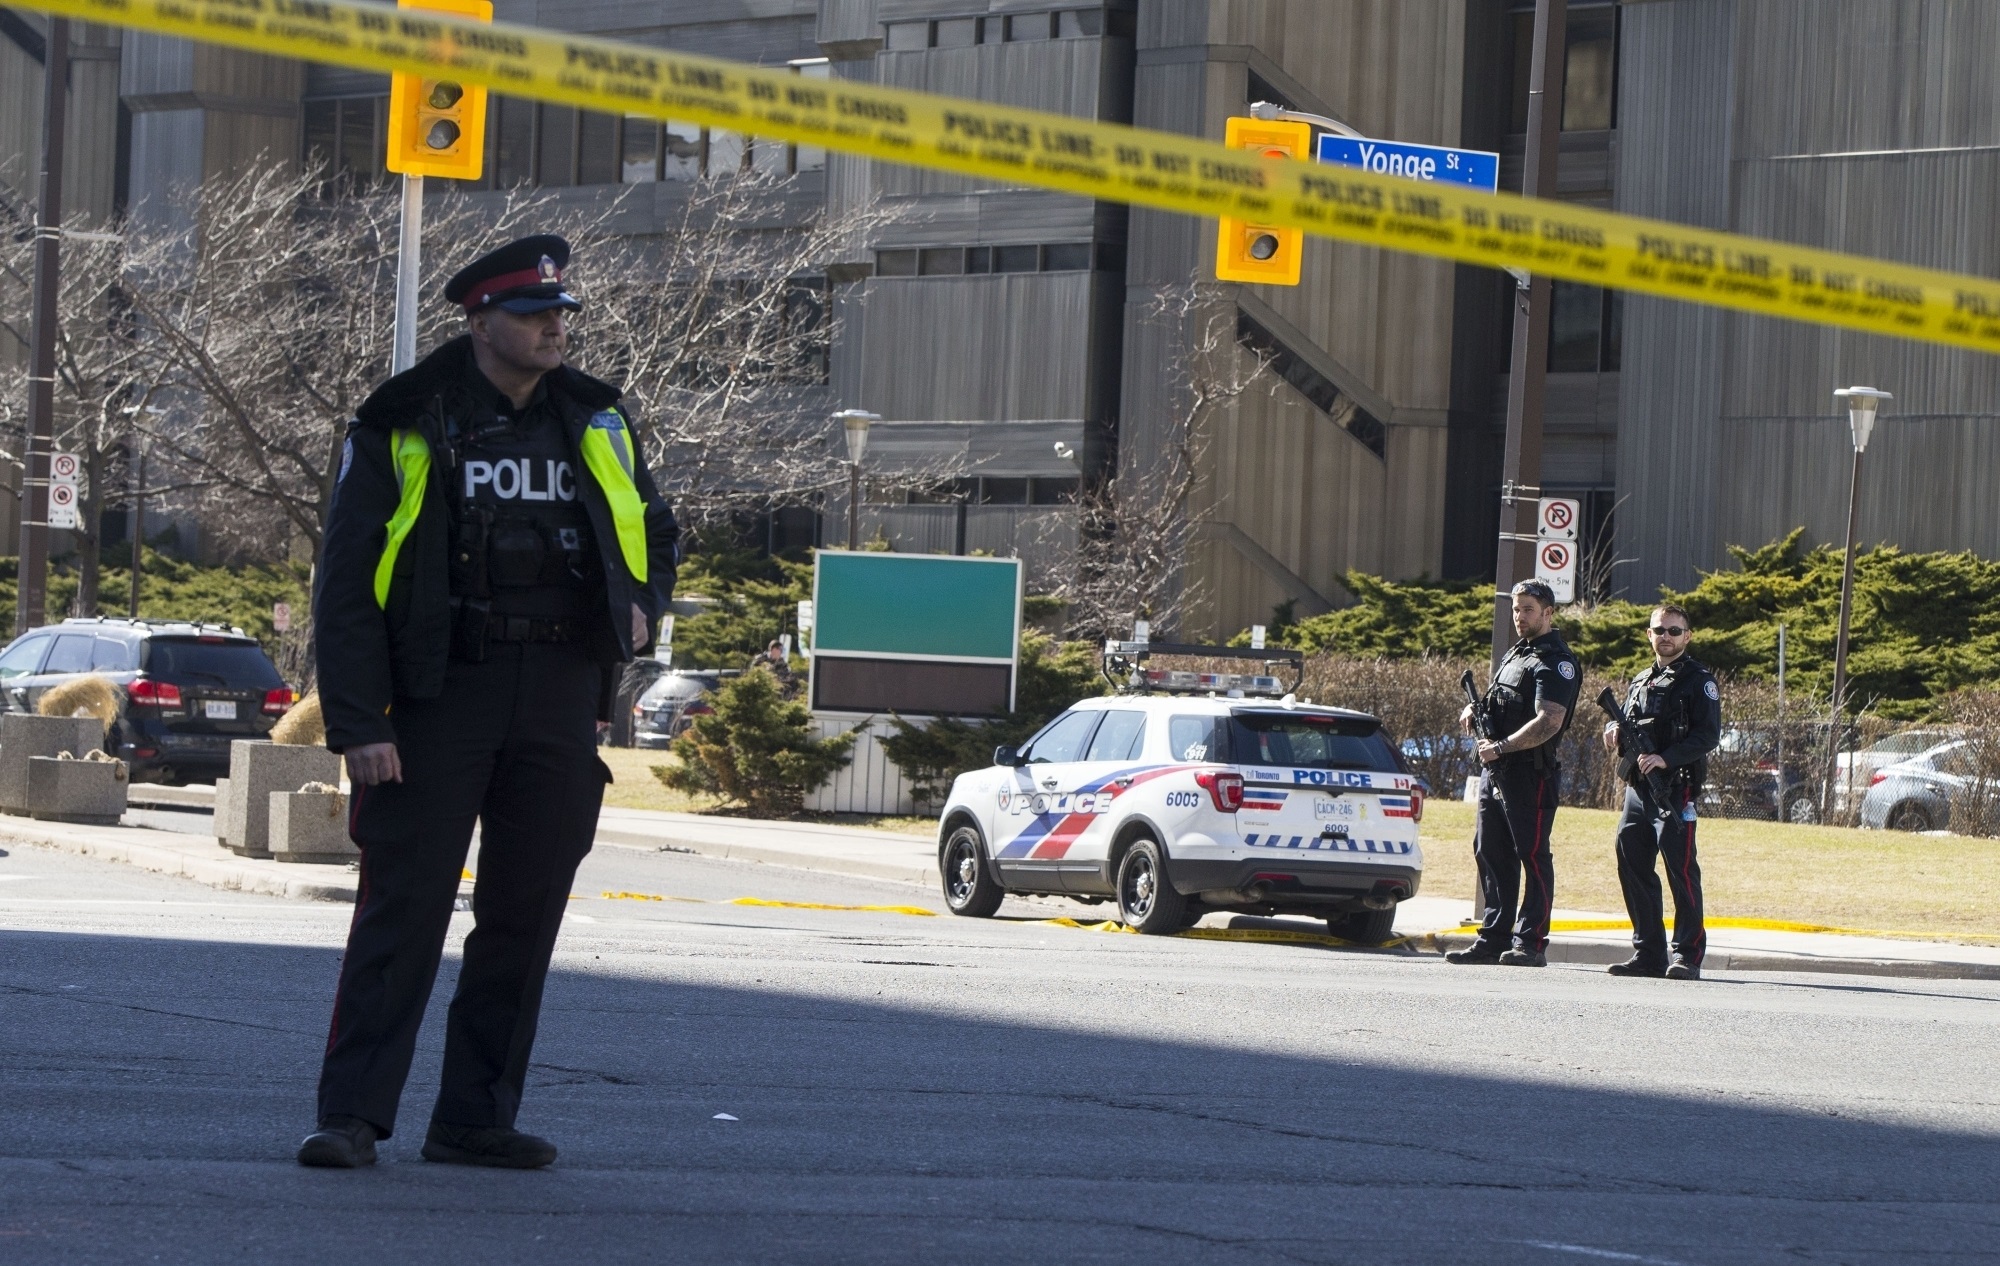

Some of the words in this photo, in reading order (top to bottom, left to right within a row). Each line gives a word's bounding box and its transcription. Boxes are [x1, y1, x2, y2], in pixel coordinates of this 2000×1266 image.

[565, 43, 659, 82] POLICE
[748, 78, 777, 102] DO
[786, 86, 827, 109] NOT
[836, 94, 907, 125] CROSS
[944, 110, 1030, 148] POLICE
[1116, 143, 1143, 167] DO
[1153, 150, 1190, 173] NOT
[1198, 158, 1265, 188] CROSS
[1359, 143, 1436, 181] Yonge
[1446, 153, 1459, 170] St
[1300, 172, 1382, 210] POLICE
[1462, 204, 1487, 228] DO
[1498, 212, 1533, 236] NOT
[1540, 218, 1604, 249] CROSS
[1637, 233, 1714, 270] POLICE
[1790, 263, 1813, 286] DO
[1823, 270, 1856, 294] NOT
[1864, 277, 1924, 307] CROSS
[465, 458, 576, 501] POLIC
[1255, 770, 1280, 781] TORONTO
[1293, 770, 1372, 788] POLICE
[1011, 792, 1113, 815] POLICE
[1166, 791, 1199, 808] 6003
[1325, 823, 1349, 833] 6003
